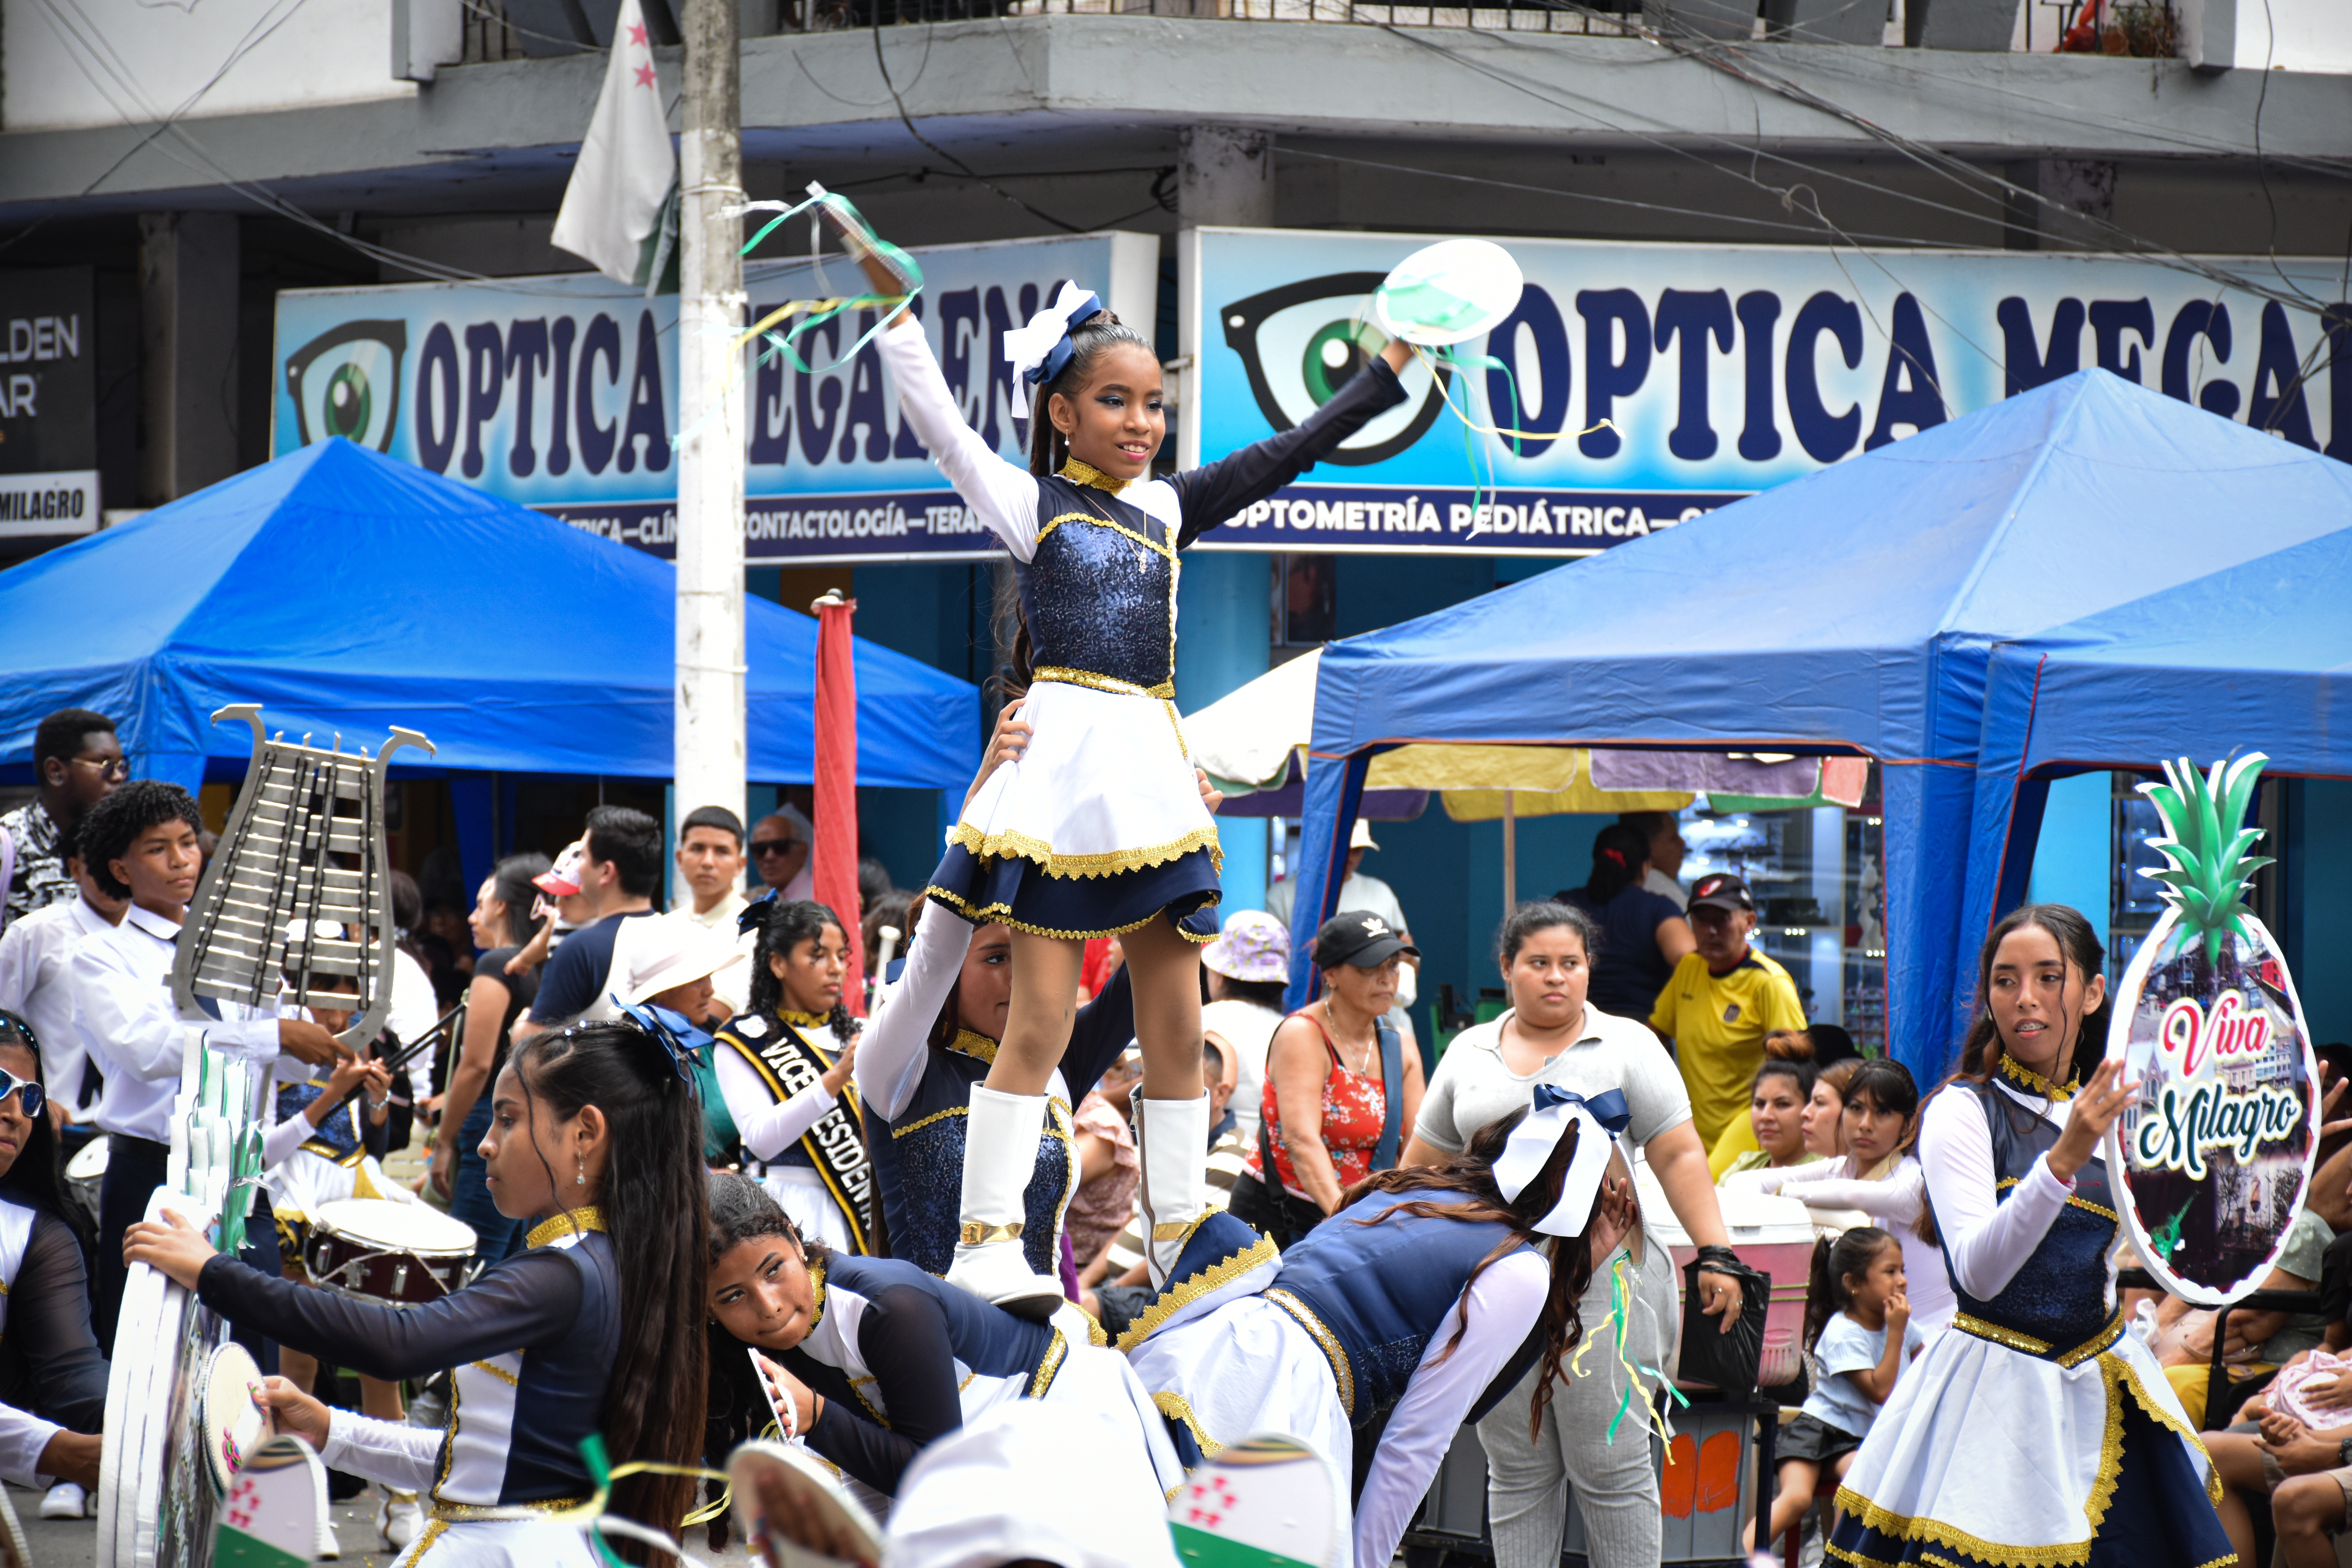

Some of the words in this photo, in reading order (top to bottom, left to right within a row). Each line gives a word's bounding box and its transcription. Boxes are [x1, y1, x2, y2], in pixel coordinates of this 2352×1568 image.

[416, 308, 671, 479] OPTICA
[1487, 283, 1948, 463] OPTICA
[2163, 997, 2271, 1076] Viva
[2139, 1083, 2298, 1172] Milagro
